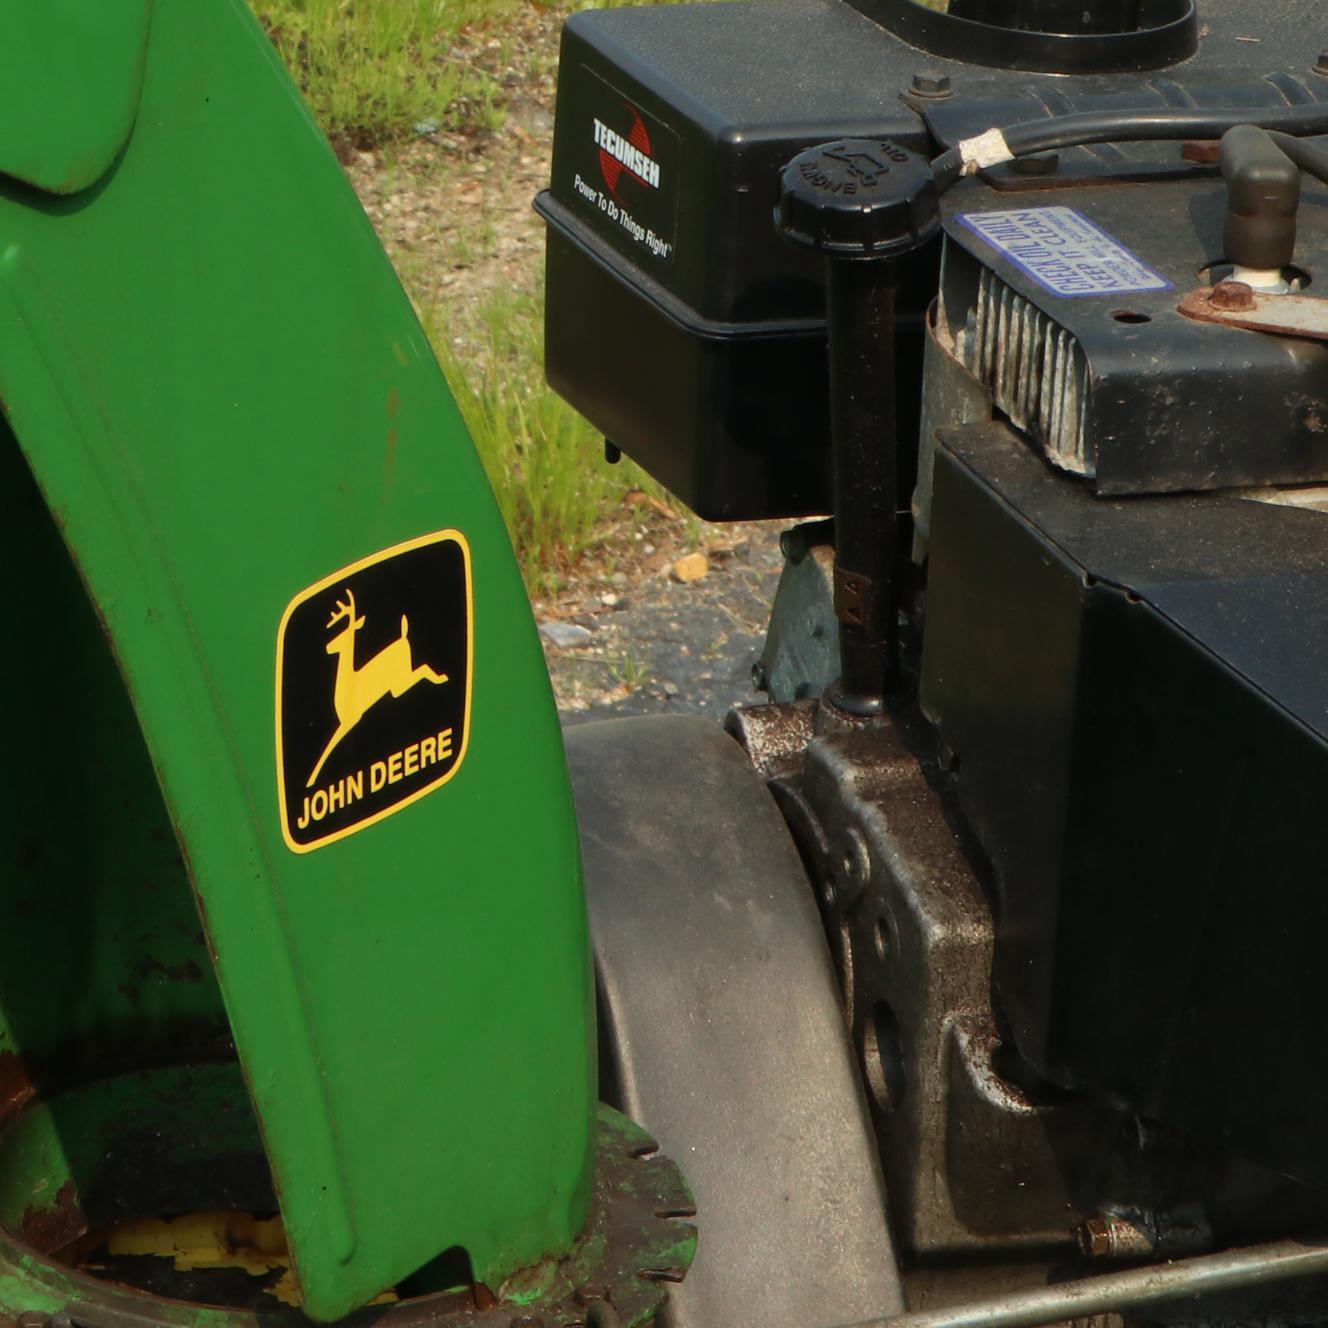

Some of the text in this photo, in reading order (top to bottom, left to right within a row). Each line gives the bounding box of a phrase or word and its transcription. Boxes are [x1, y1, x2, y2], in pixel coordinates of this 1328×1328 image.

[594, 117, 660, 188] TECUMSEH
[574, 174, 597, 202] Power
[598, 191, 607, 212] To
[608, 200, 619, 220] Do
[620, 208, 645, 241] Things
[970, 215, 1095, 290] CHECK OIL DAILY
[1010, 213, 1122, 288] KEEP IT CLEAN
[297, 728, 453, 830] JOHN DEERE
